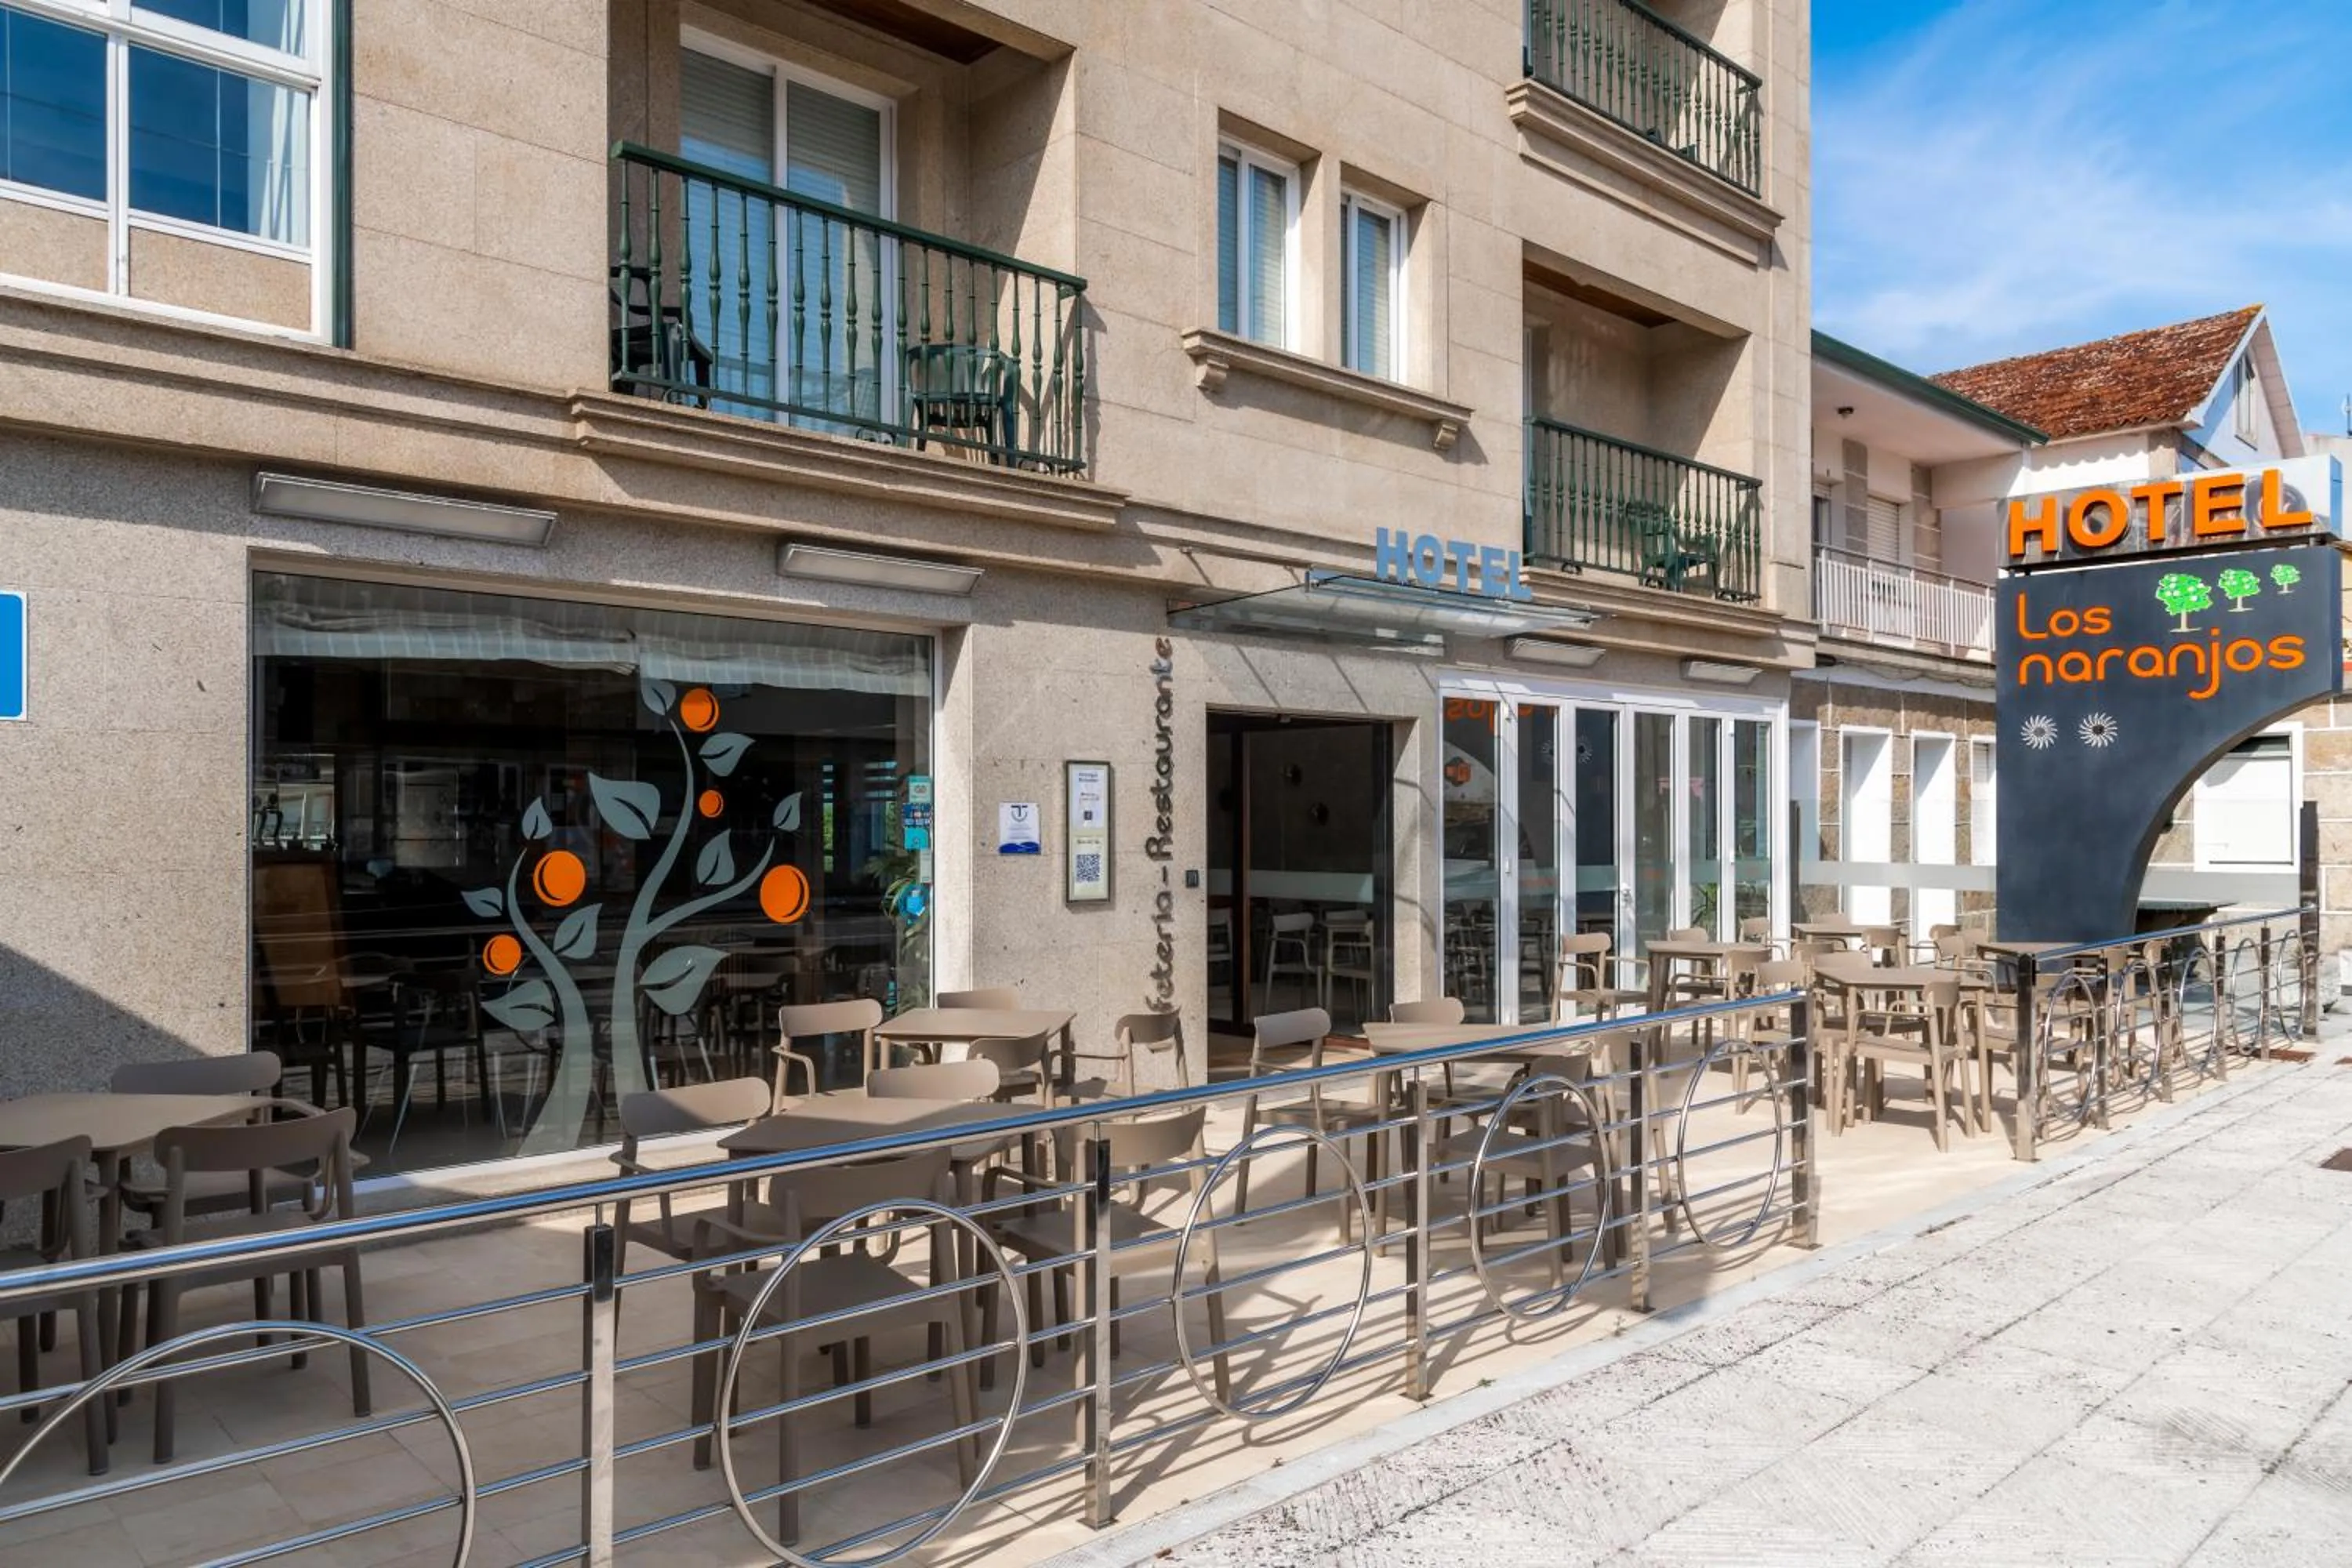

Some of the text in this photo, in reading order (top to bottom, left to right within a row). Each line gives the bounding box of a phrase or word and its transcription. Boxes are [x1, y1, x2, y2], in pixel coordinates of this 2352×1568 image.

[2009, 467, 2313, 557] HOTEL
[1376, 526, 1532, 601] HOTEL
[2017, 590, 2113, 640] Los
[2018, 628, 2306, 699] naranjos
